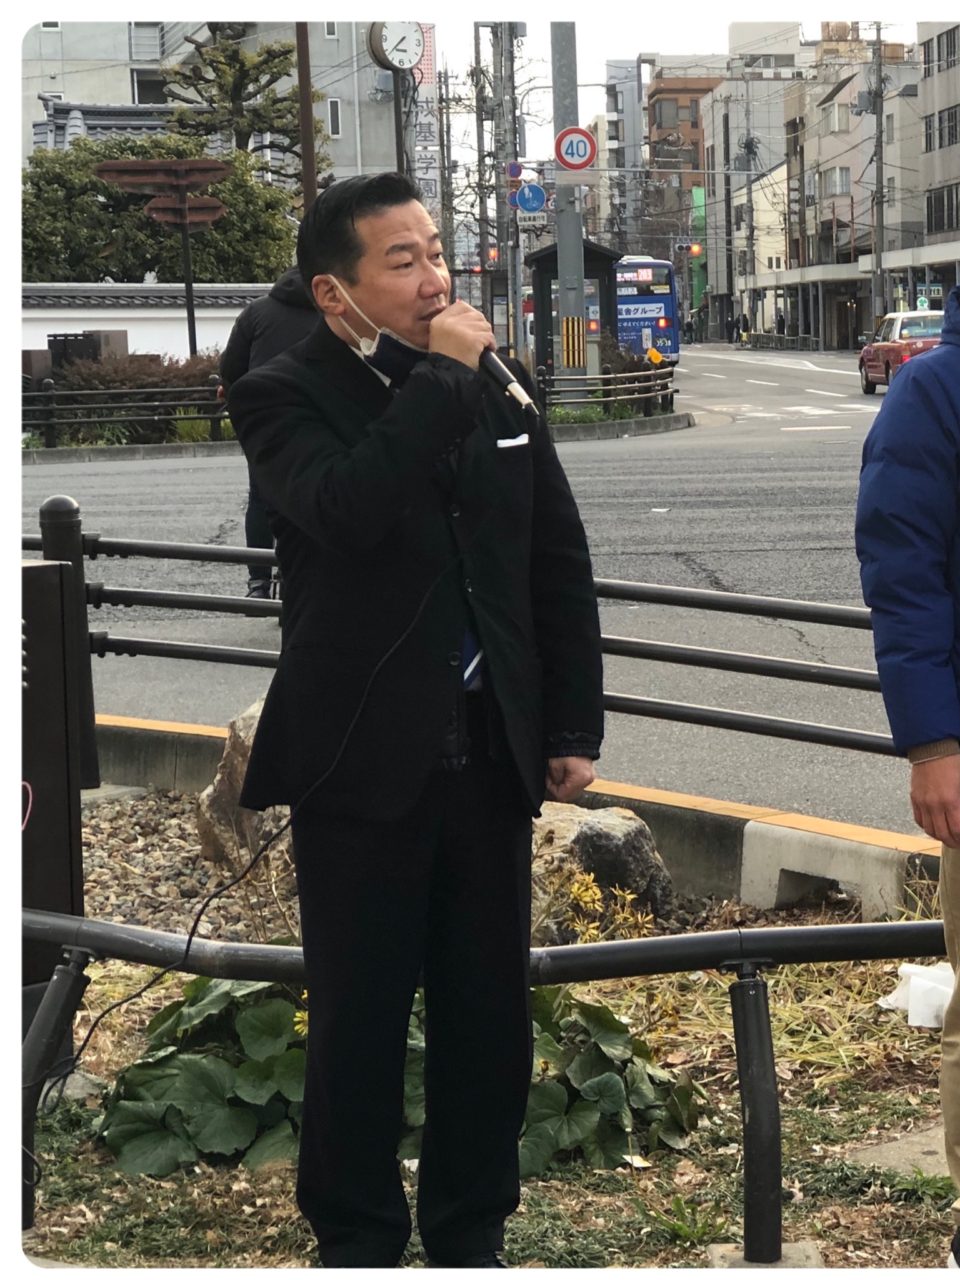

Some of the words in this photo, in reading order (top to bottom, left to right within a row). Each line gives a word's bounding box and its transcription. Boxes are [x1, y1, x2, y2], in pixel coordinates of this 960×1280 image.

[415, 38, 422, 47] 3
[398, 58, 405, 67] 6
[565, 140, 587, 158] 40
